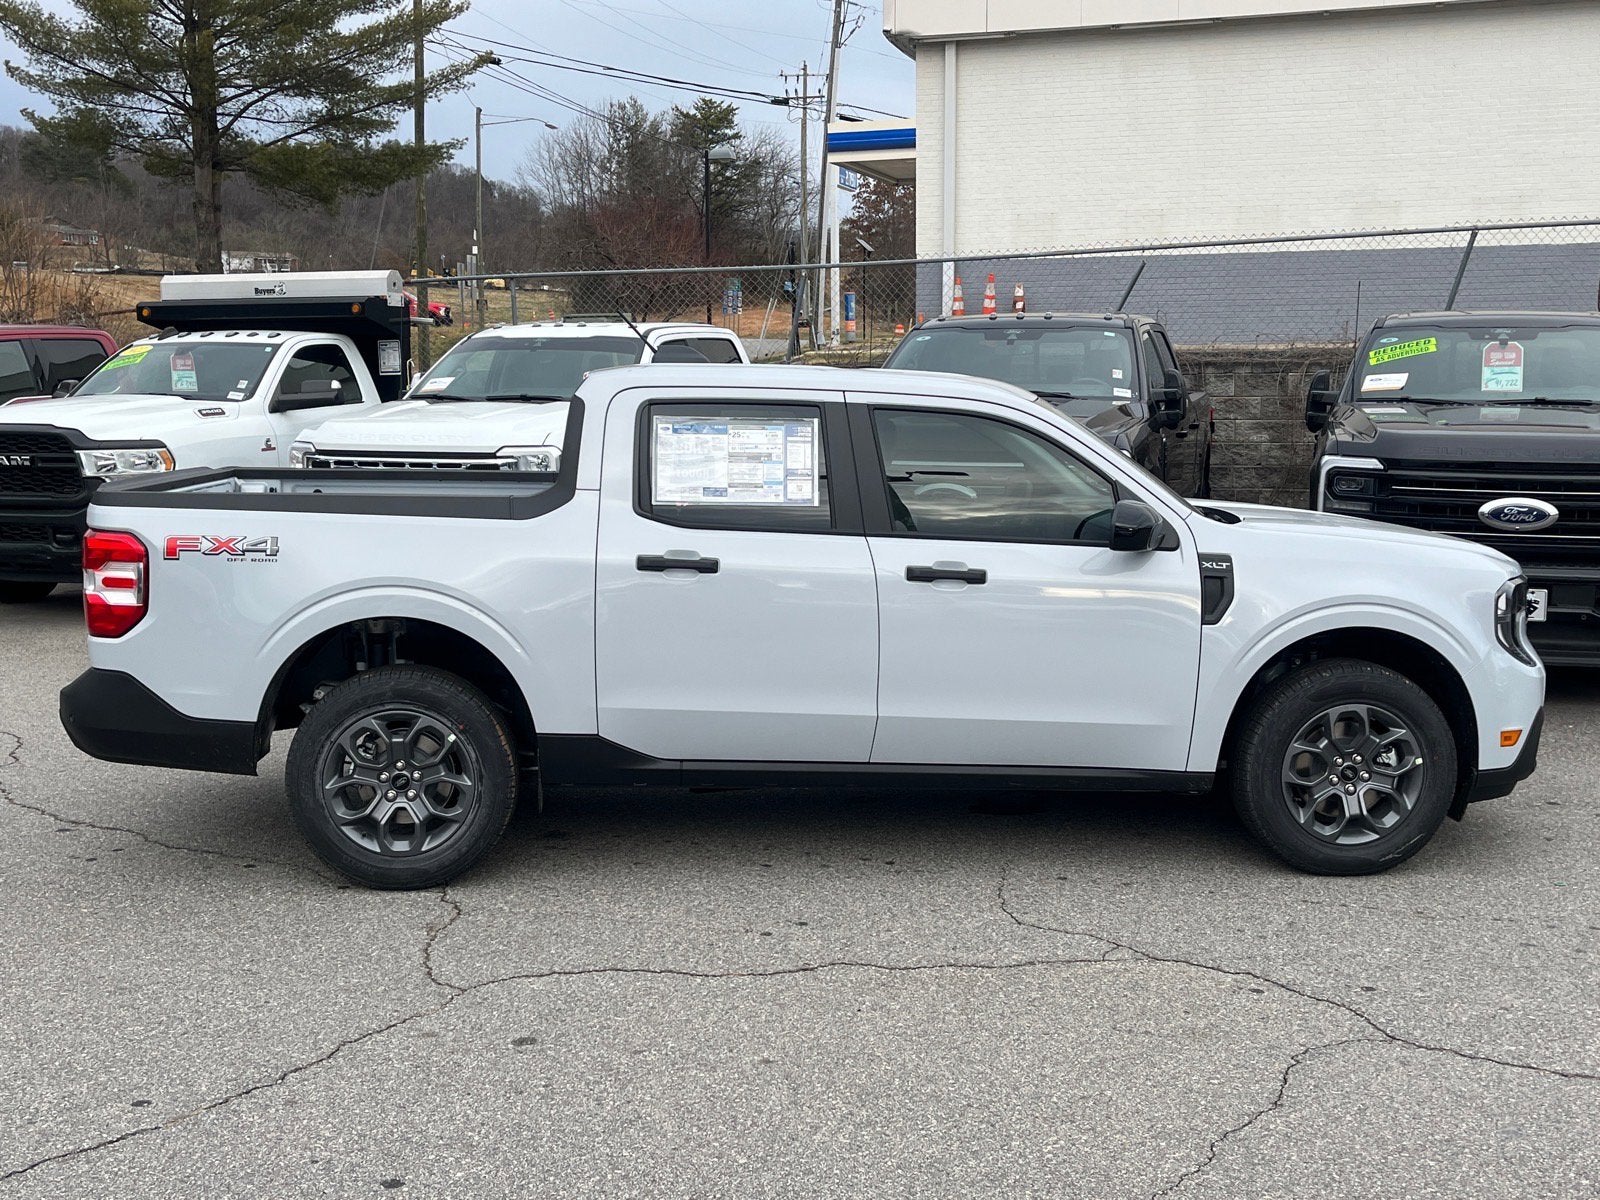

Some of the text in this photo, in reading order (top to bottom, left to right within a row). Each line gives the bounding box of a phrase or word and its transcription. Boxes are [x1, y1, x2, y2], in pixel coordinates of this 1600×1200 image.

[254, 287, 276, 296] Buyers
[1373, 338, 1431, 356] REDUCED
[1386, 346, 1429, 359] ADVERTISED
[0, 455, 30, 466] AM
[1500, 506, 1538, 522] Ford
[163, 535, 280, 560] FX4
[1201, 561, 1231, 569] XLT
